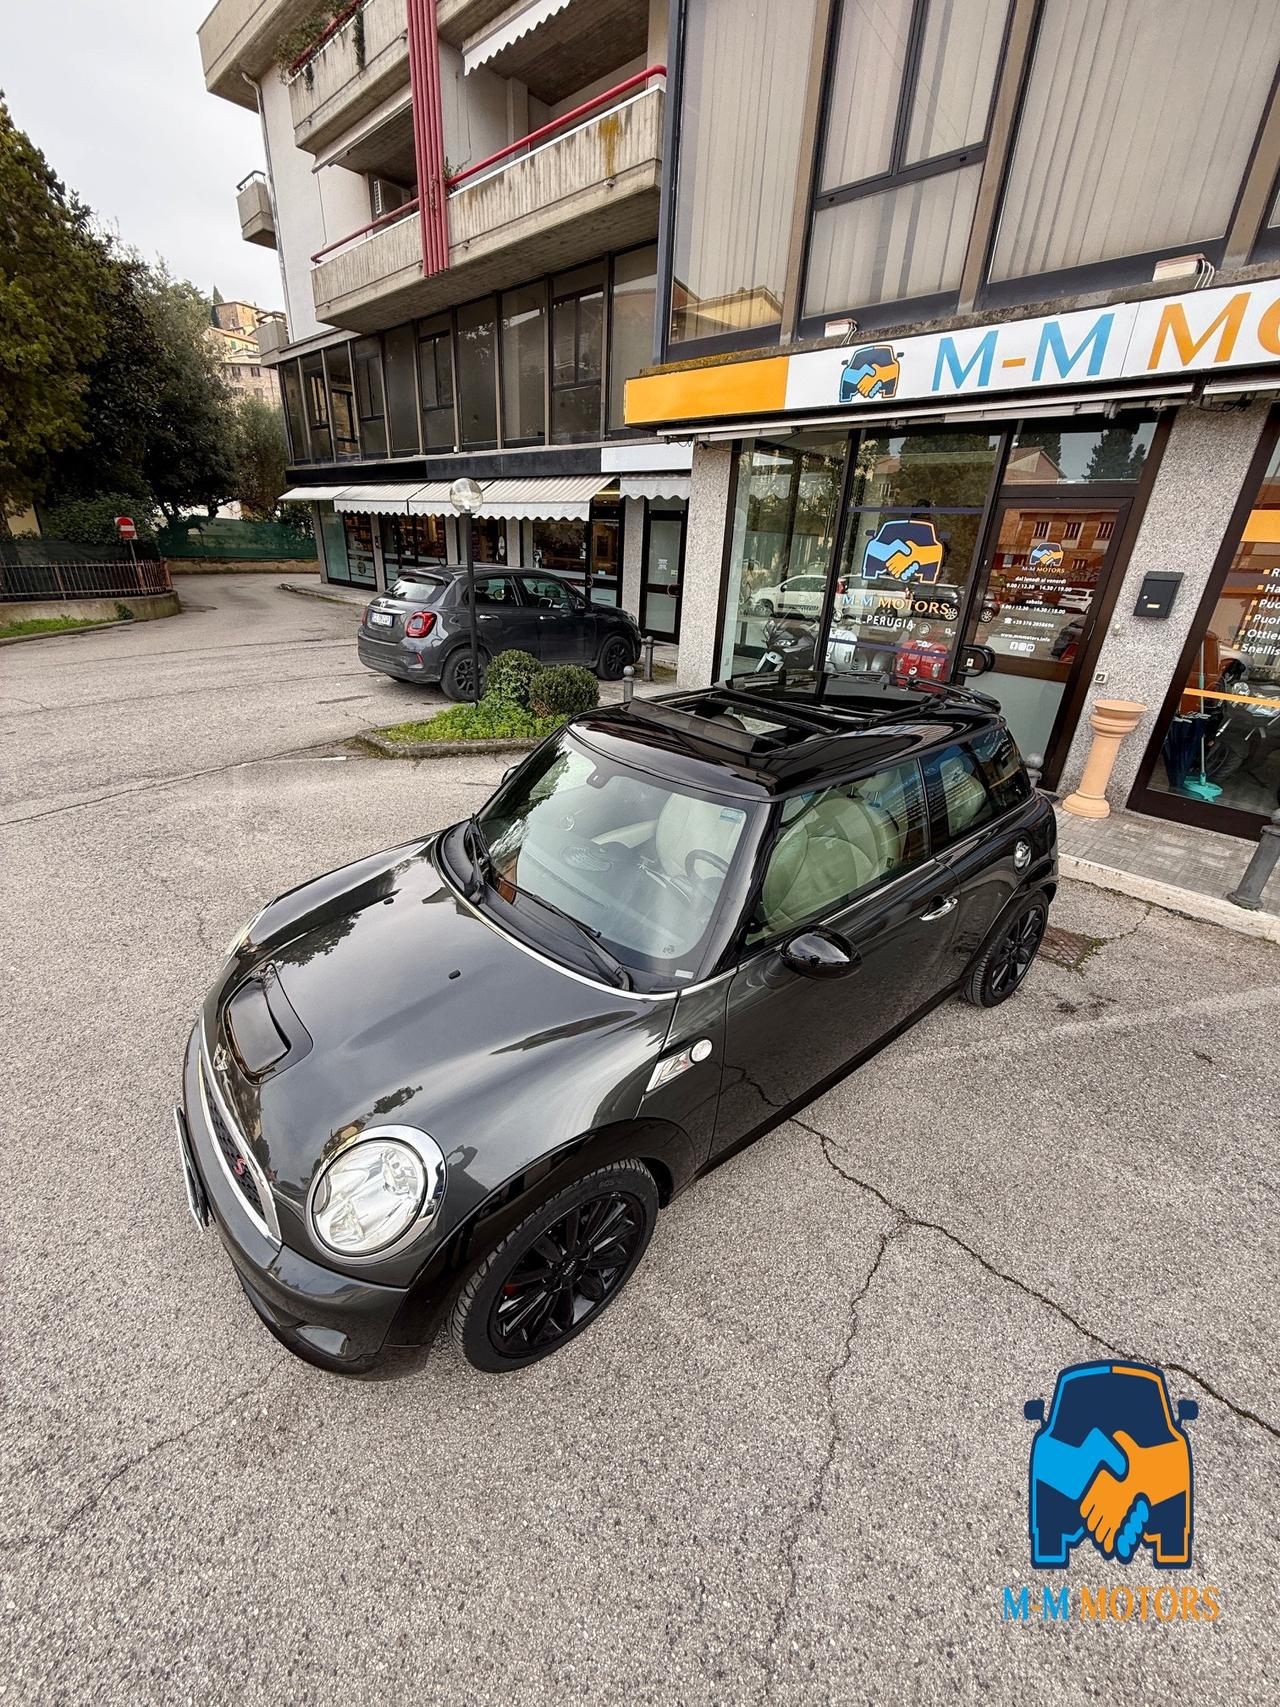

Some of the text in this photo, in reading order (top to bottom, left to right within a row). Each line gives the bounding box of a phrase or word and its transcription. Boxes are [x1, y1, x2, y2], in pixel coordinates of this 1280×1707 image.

[931, 313, 1115, 391] M-M
[1036, 566, 1065, 574] MOTORS
[878, 597, 950, 616] MOTORS
[866, 615, 914, 632] PERUGIA
